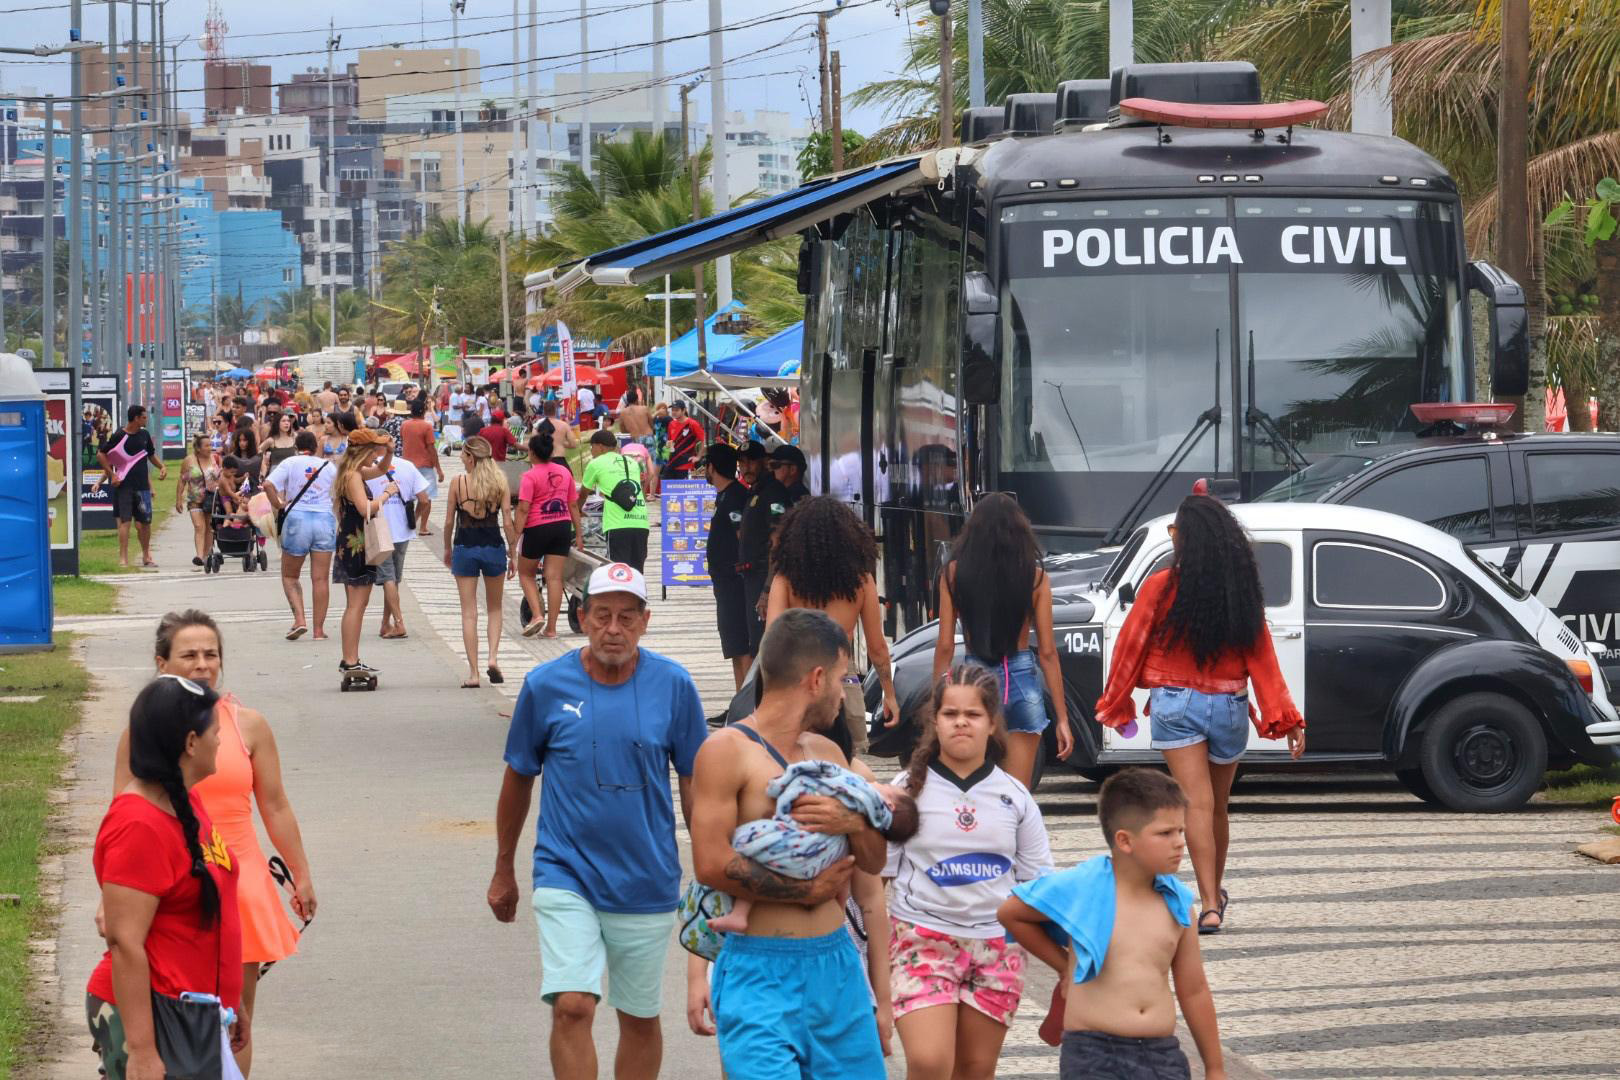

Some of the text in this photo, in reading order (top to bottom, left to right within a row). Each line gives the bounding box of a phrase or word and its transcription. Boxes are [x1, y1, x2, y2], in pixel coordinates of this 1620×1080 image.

[1042, 225, 1407, 267] POLICIA CIVIL
[1064, 632, 1101, 653] 10-A
[930, 859, 1003, 879] SAMSUNG
